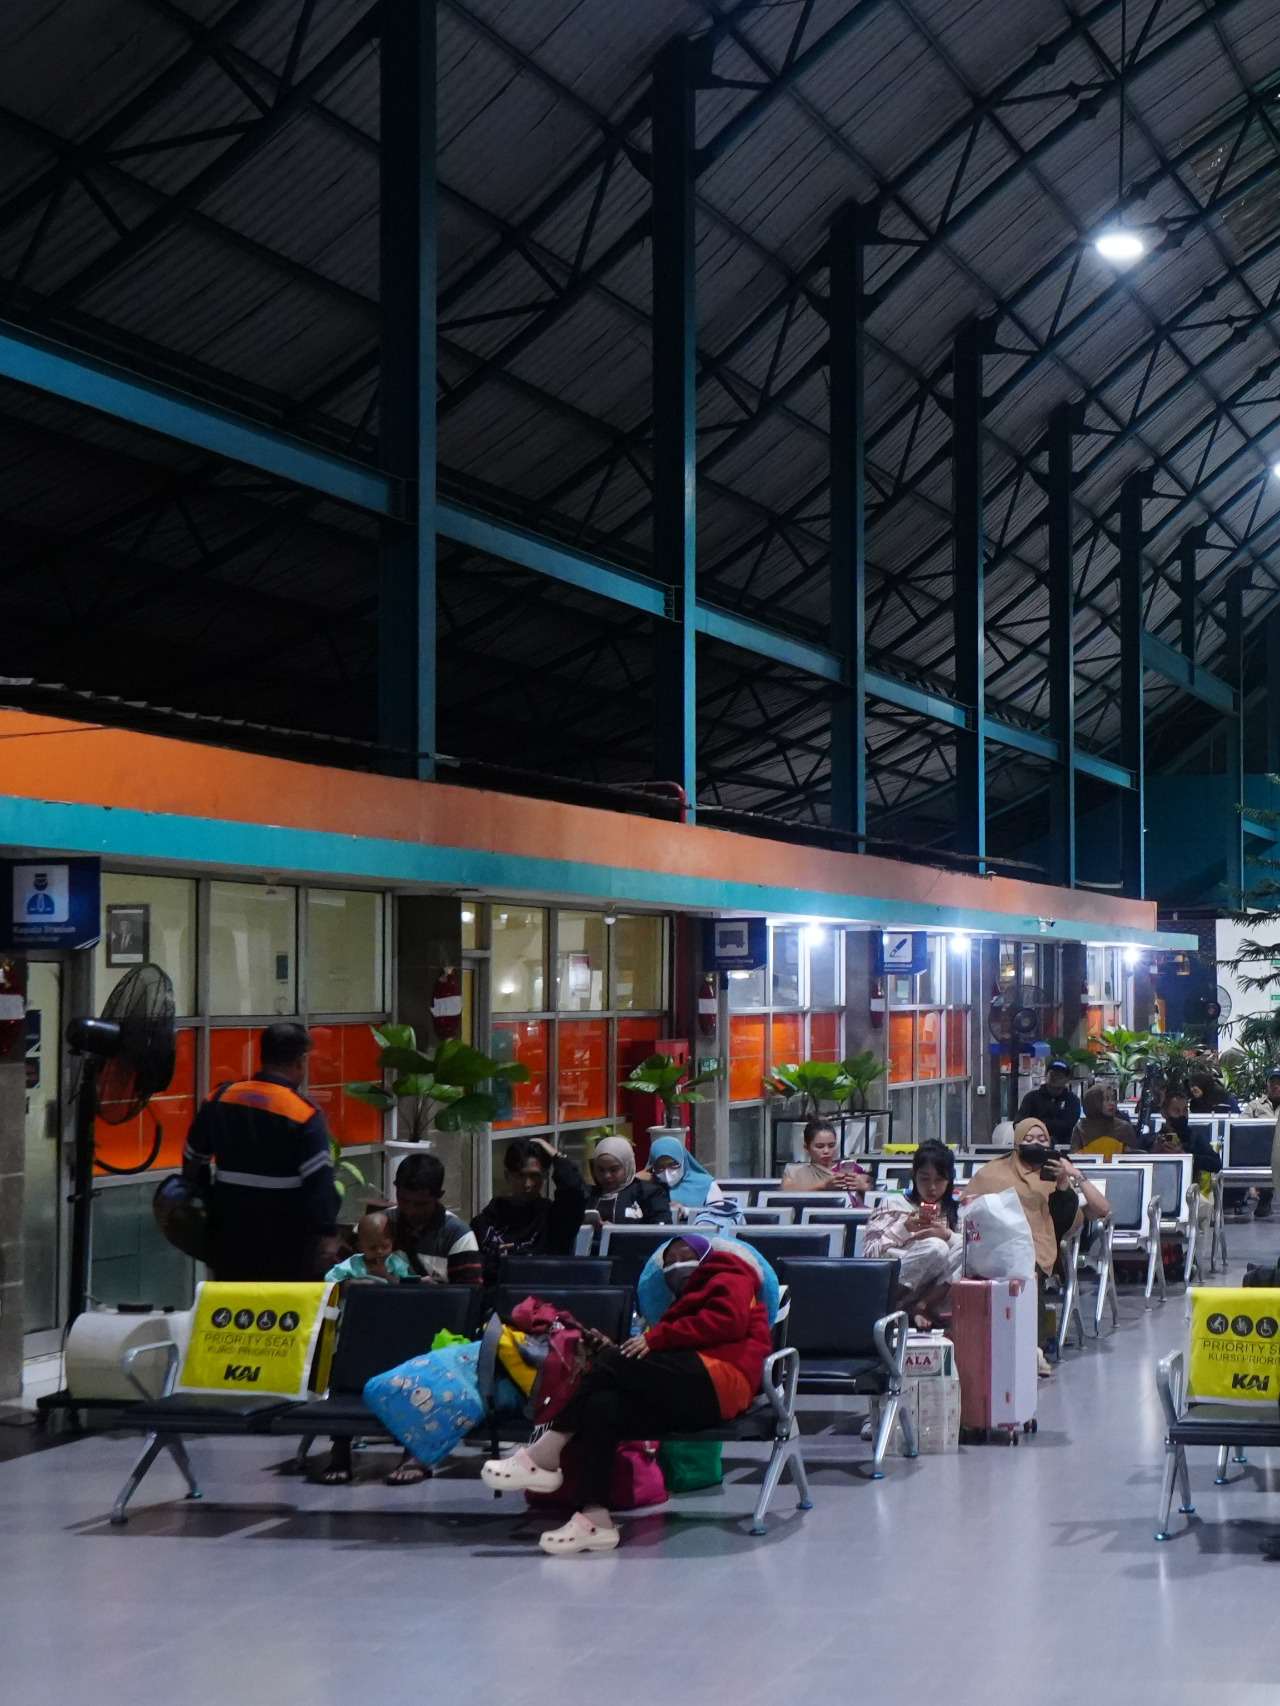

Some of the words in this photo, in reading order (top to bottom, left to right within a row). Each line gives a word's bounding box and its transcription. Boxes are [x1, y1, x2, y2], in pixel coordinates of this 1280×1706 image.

[204, 1333, 262, 1347] PRIORITY
[265, 1337, 296, 1348] SEAT
[1203, 1340, 1266, 1355] PRIORITY
[1208, 1353, 1239, 1363] KURSI
[223, 1364, 262, 1382] KAI
[1231, 1373, 1270, 1392] KAI
